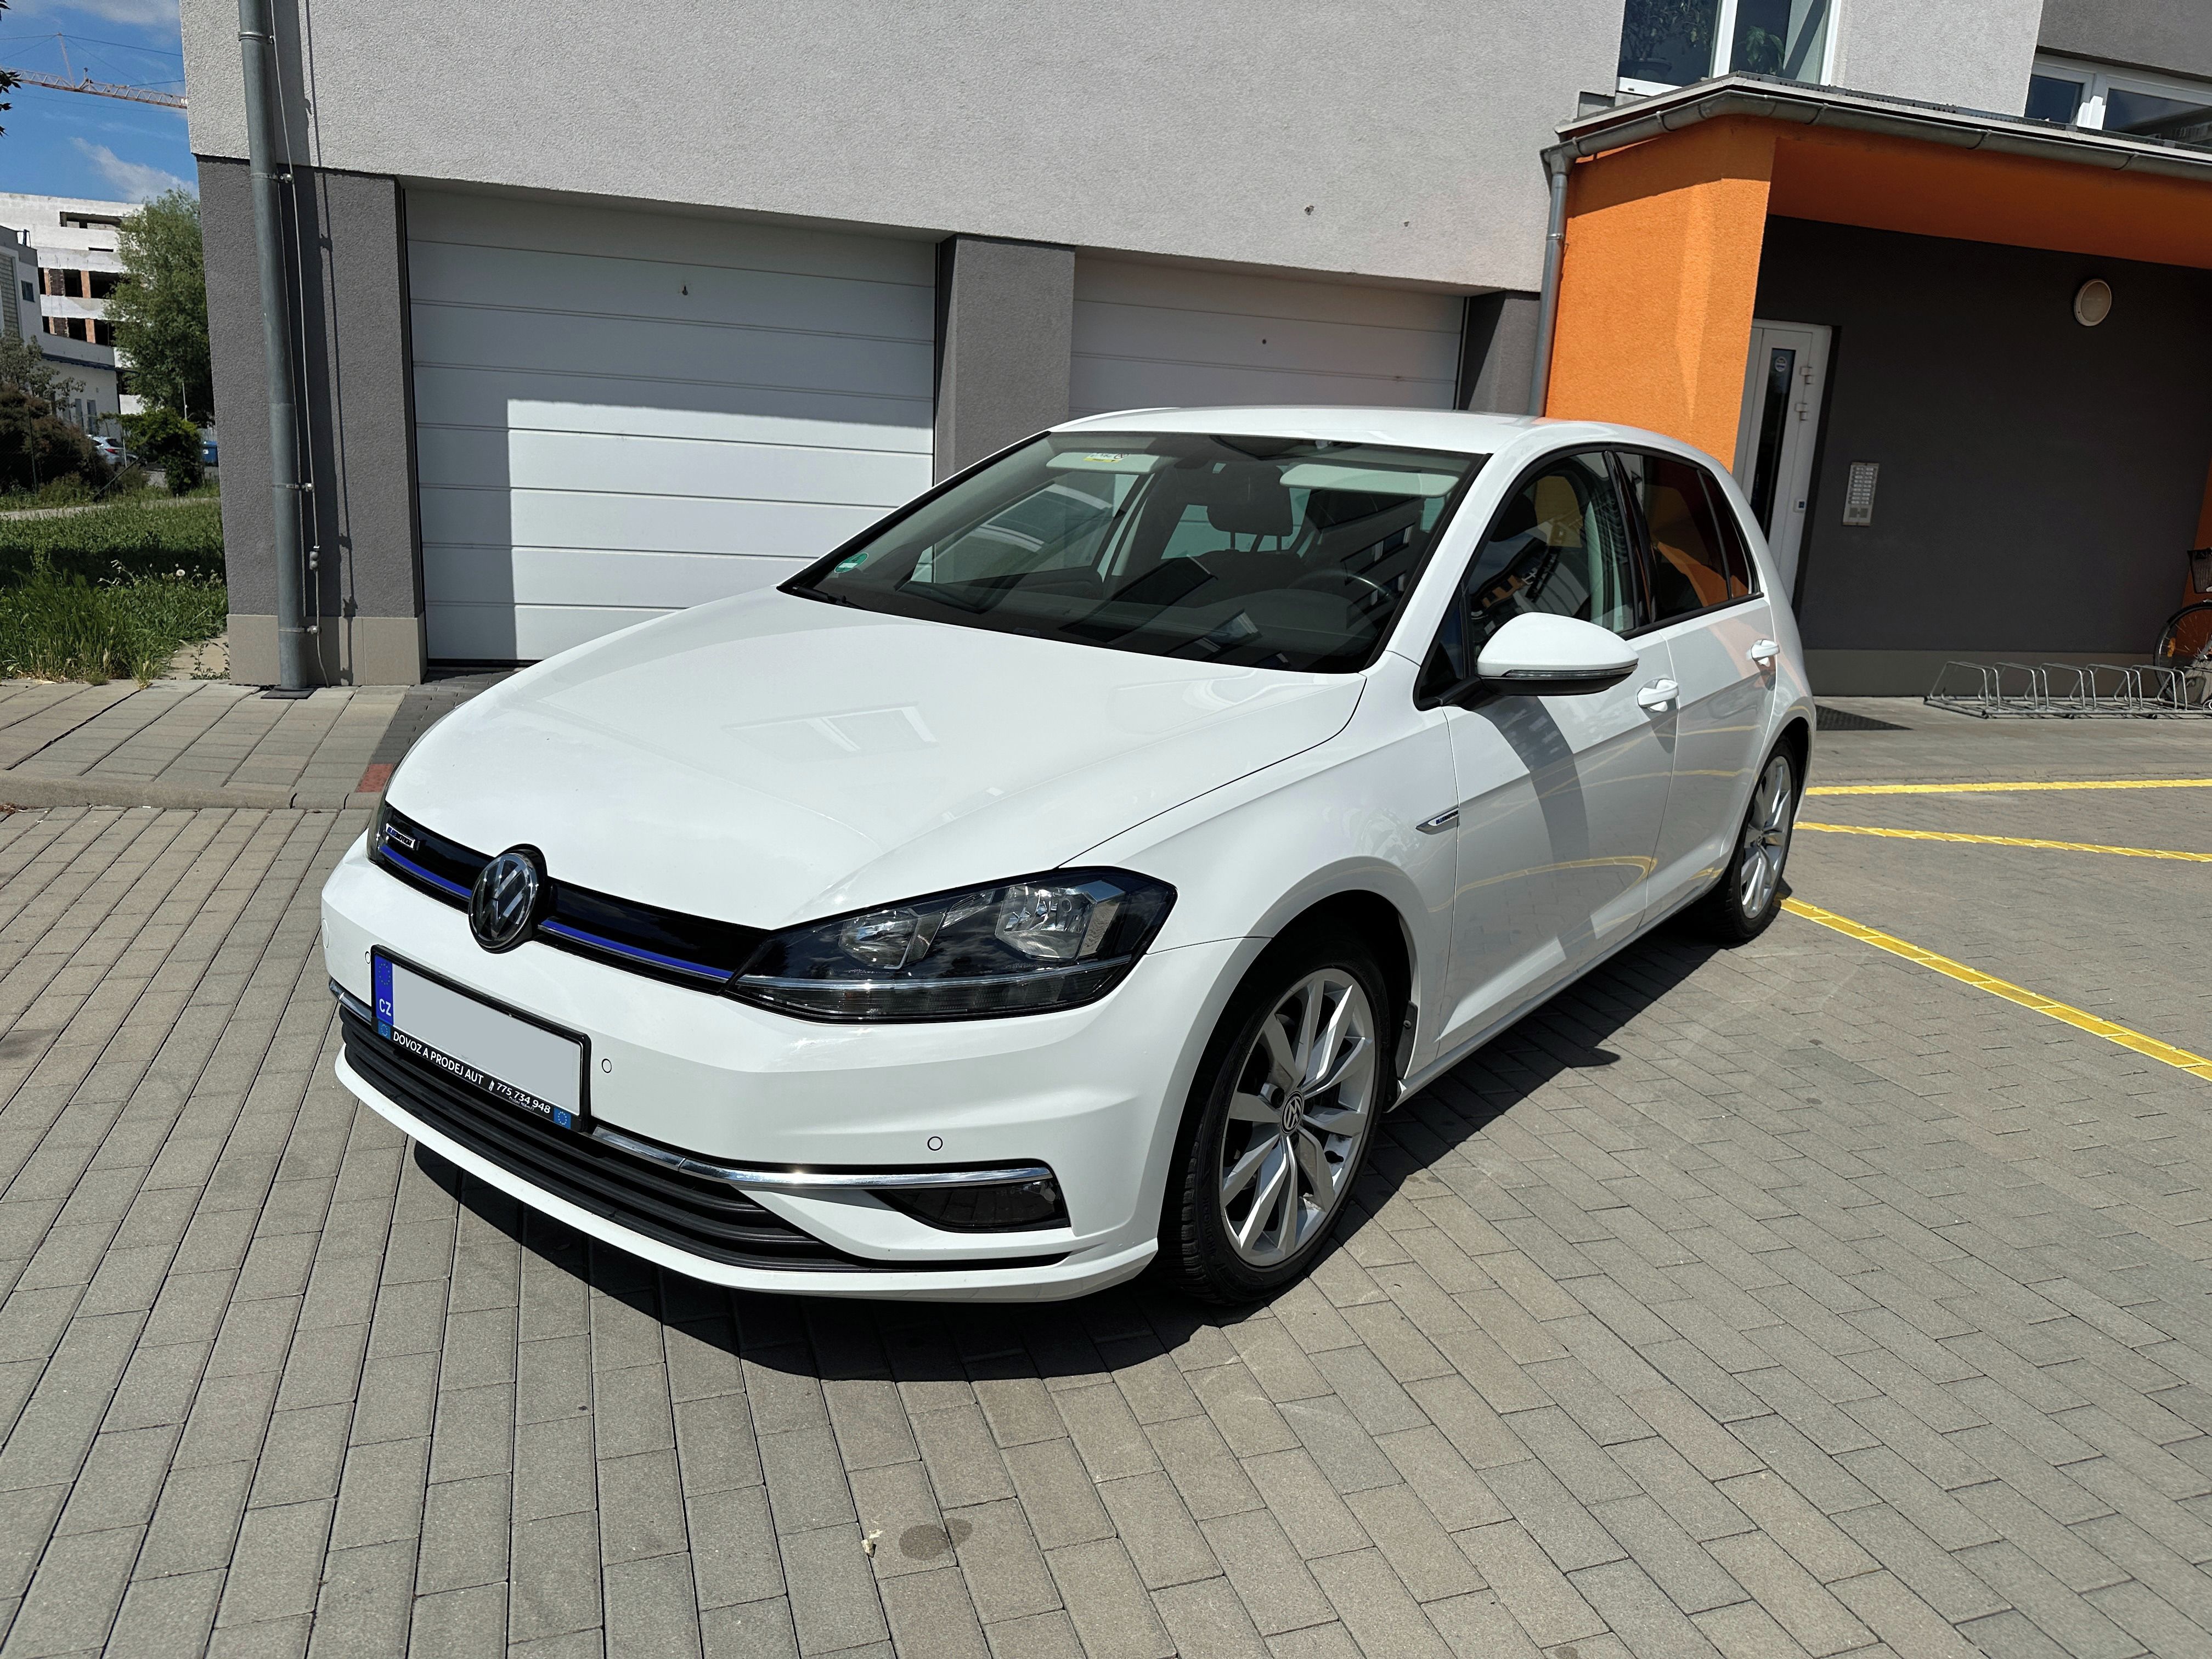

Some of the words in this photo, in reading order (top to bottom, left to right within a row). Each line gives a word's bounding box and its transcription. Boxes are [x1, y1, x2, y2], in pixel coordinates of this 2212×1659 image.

[379, 998, 392, 1017] CZ
[393, 1031, 422, 1054] DOVOZ
[422, 1047, 429, 1059] A
[430, 1051, 464, 1075] PRODEJ
[464, 1069, 484, 1085] AUT
[496, 1082, 513, 1096] 775
[514, 1090, 531, 1104] 734
[532, 1099, 551, 1114] 948
